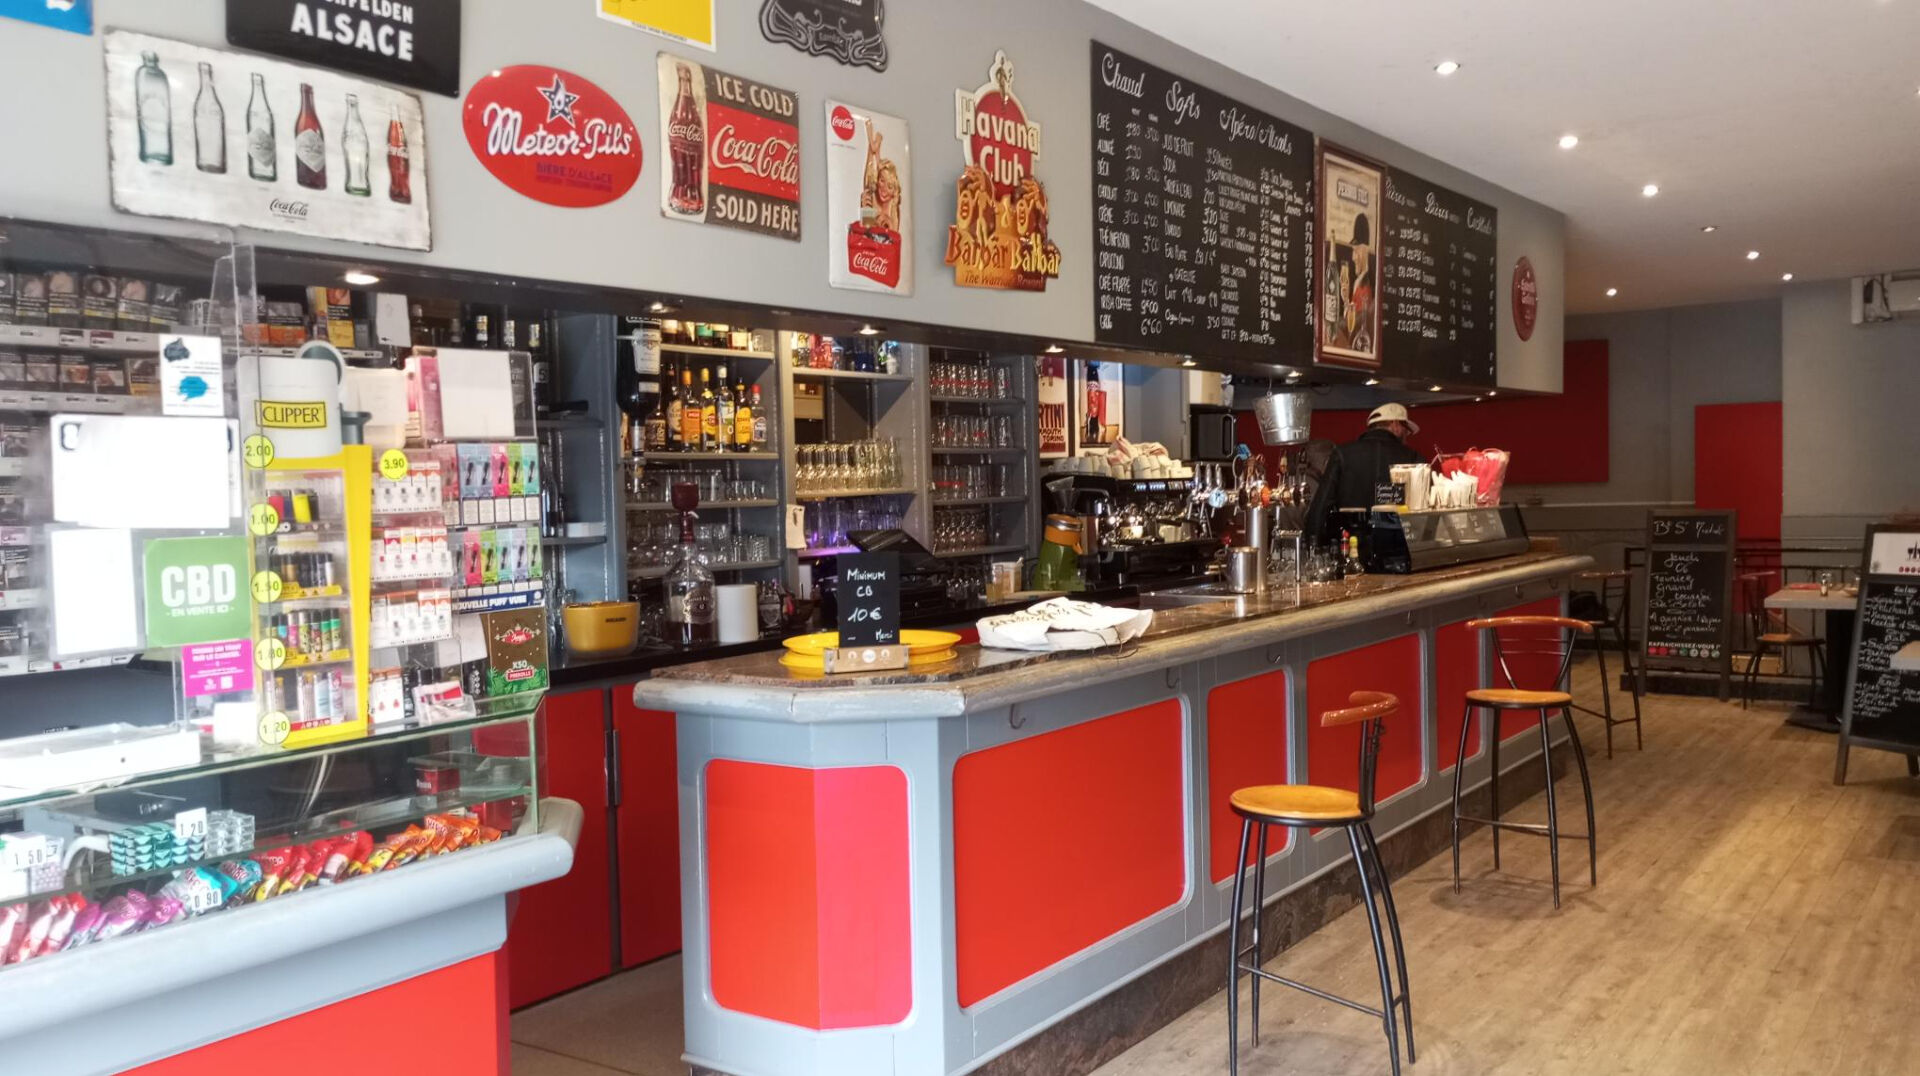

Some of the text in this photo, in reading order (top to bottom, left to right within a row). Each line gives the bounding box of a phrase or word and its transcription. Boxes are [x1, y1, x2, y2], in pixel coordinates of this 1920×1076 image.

[291, 2, 413, 62] ALSACE
[715, 74, 793, 117] ICE COLD
[1102, 53, 1145, 98] Chaud
[1166, 81, 1200, 125] Softs
[483, 102, 632, 159] Meteor-Pils
[961, 97, 1041, 155] Havana
[980, 146, 1023, 187] Club
[715, 194, 799, 233] SOLD HERE
[262, 405, 320, 424] CLIPPER
[245, 444, 271, 456] 2.00
[384, 457, 405, 470] 3.90
[251, 514, 275, 526] 1.00
[161, 563, 236, 608] CBD
[856, 585, 873, 597] CB
[171, 608, 186, 618] EN
[187, 606, 215, 617] VENTE
